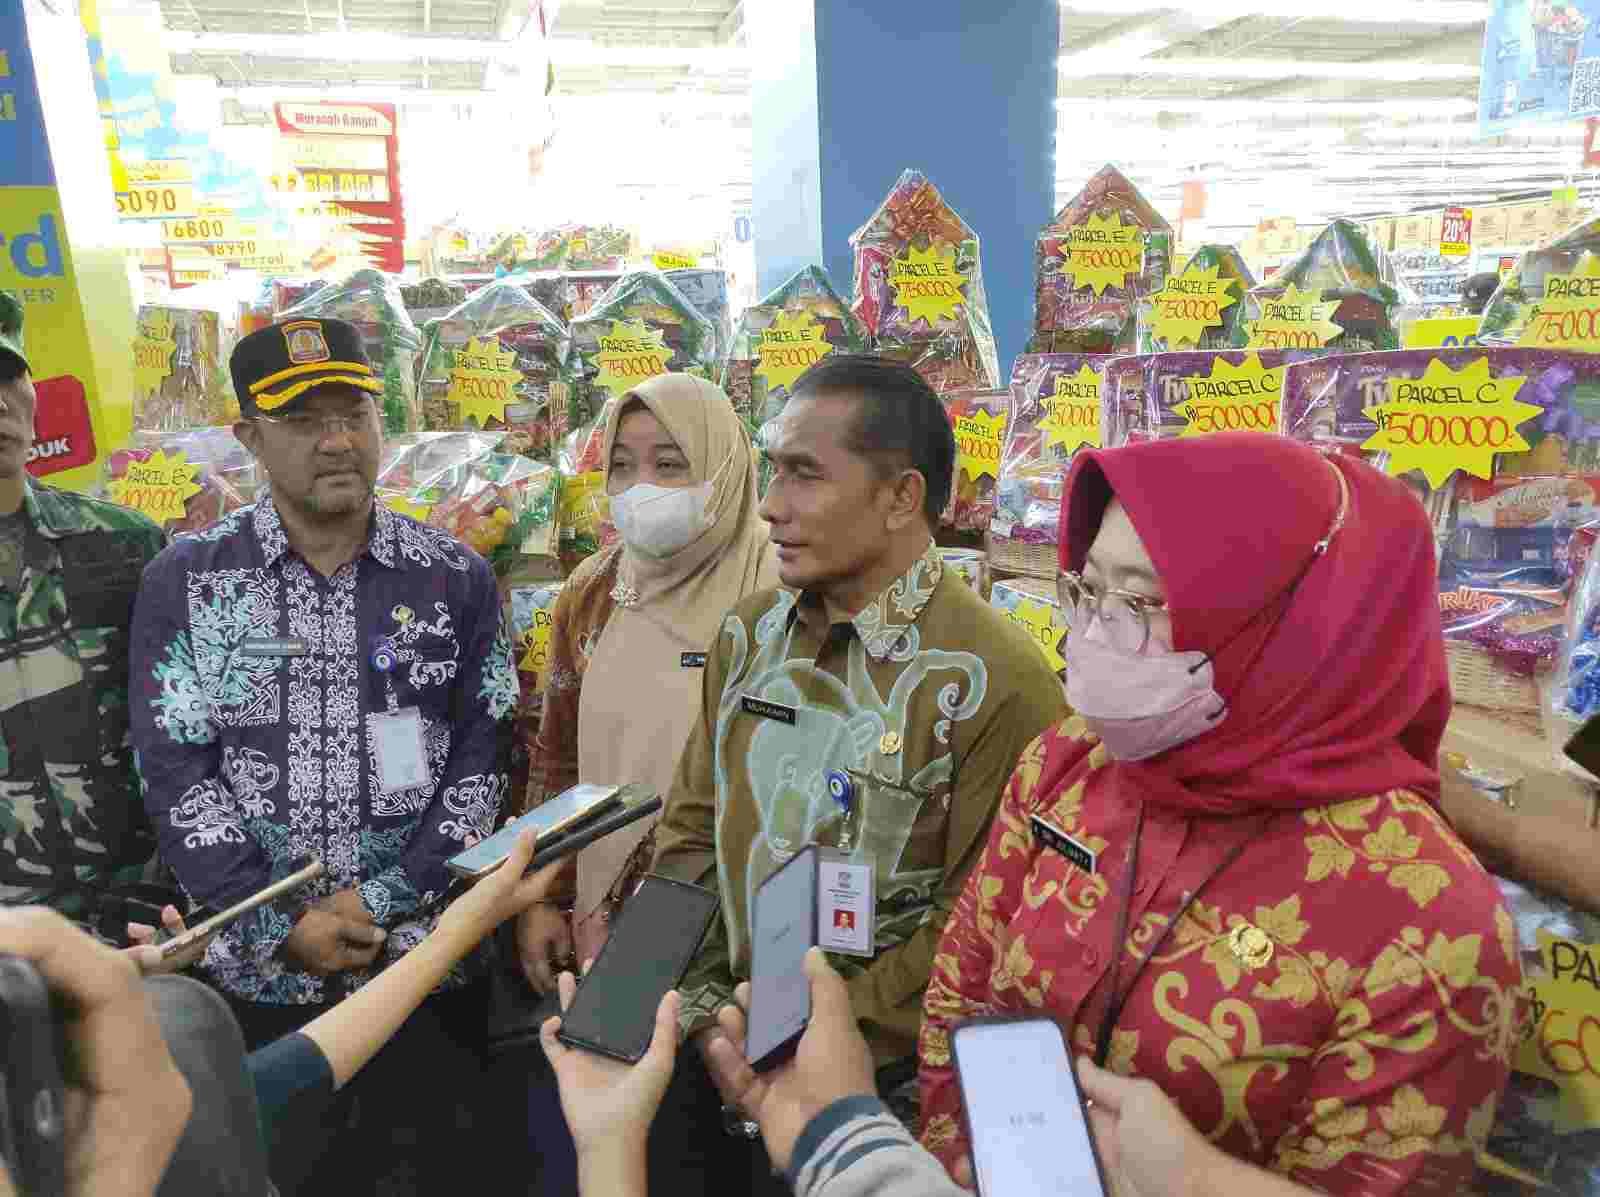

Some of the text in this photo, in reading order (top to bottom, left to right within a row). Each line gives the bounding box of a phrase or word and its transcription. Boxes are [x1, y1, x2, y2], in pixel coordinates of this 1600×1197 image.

[1443, 217, 1473, 242] 20%
[1194, 374, 1281, 399] PARCEL C
[1398, 382, 1500, 404] PARCEL C
